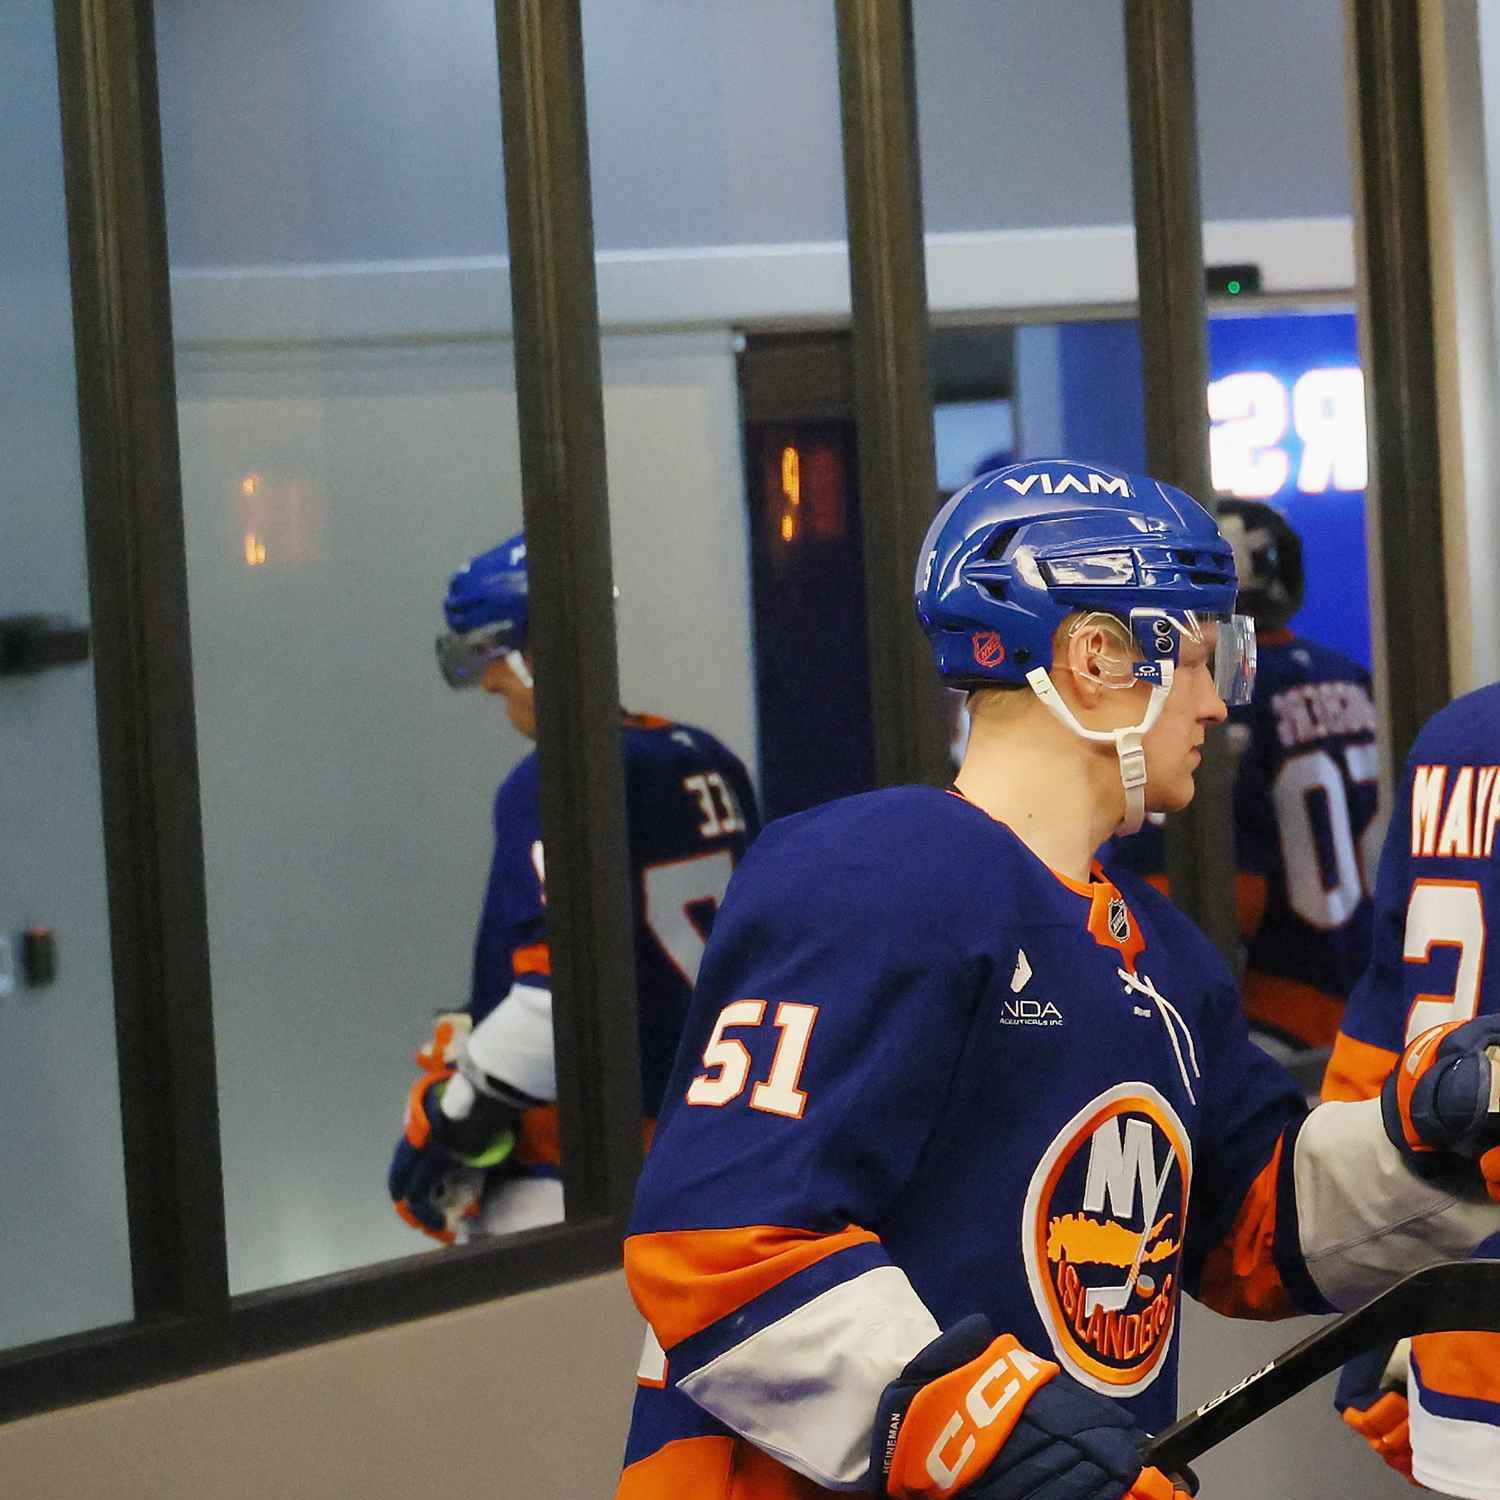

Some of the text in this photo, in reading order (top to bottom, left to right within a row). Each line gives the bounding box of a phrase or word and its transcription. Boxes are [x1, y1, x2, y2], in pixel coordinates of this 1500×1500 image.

[1003, 473, 1130, 498] VIAM
[686, 998, 819, 1119] 51
[1001, 1000, 1063, 1018] NDA
[1083, 1115, 1175, 1222] NY
[1057, 1260, 1172, 1359] ISLANDERS
